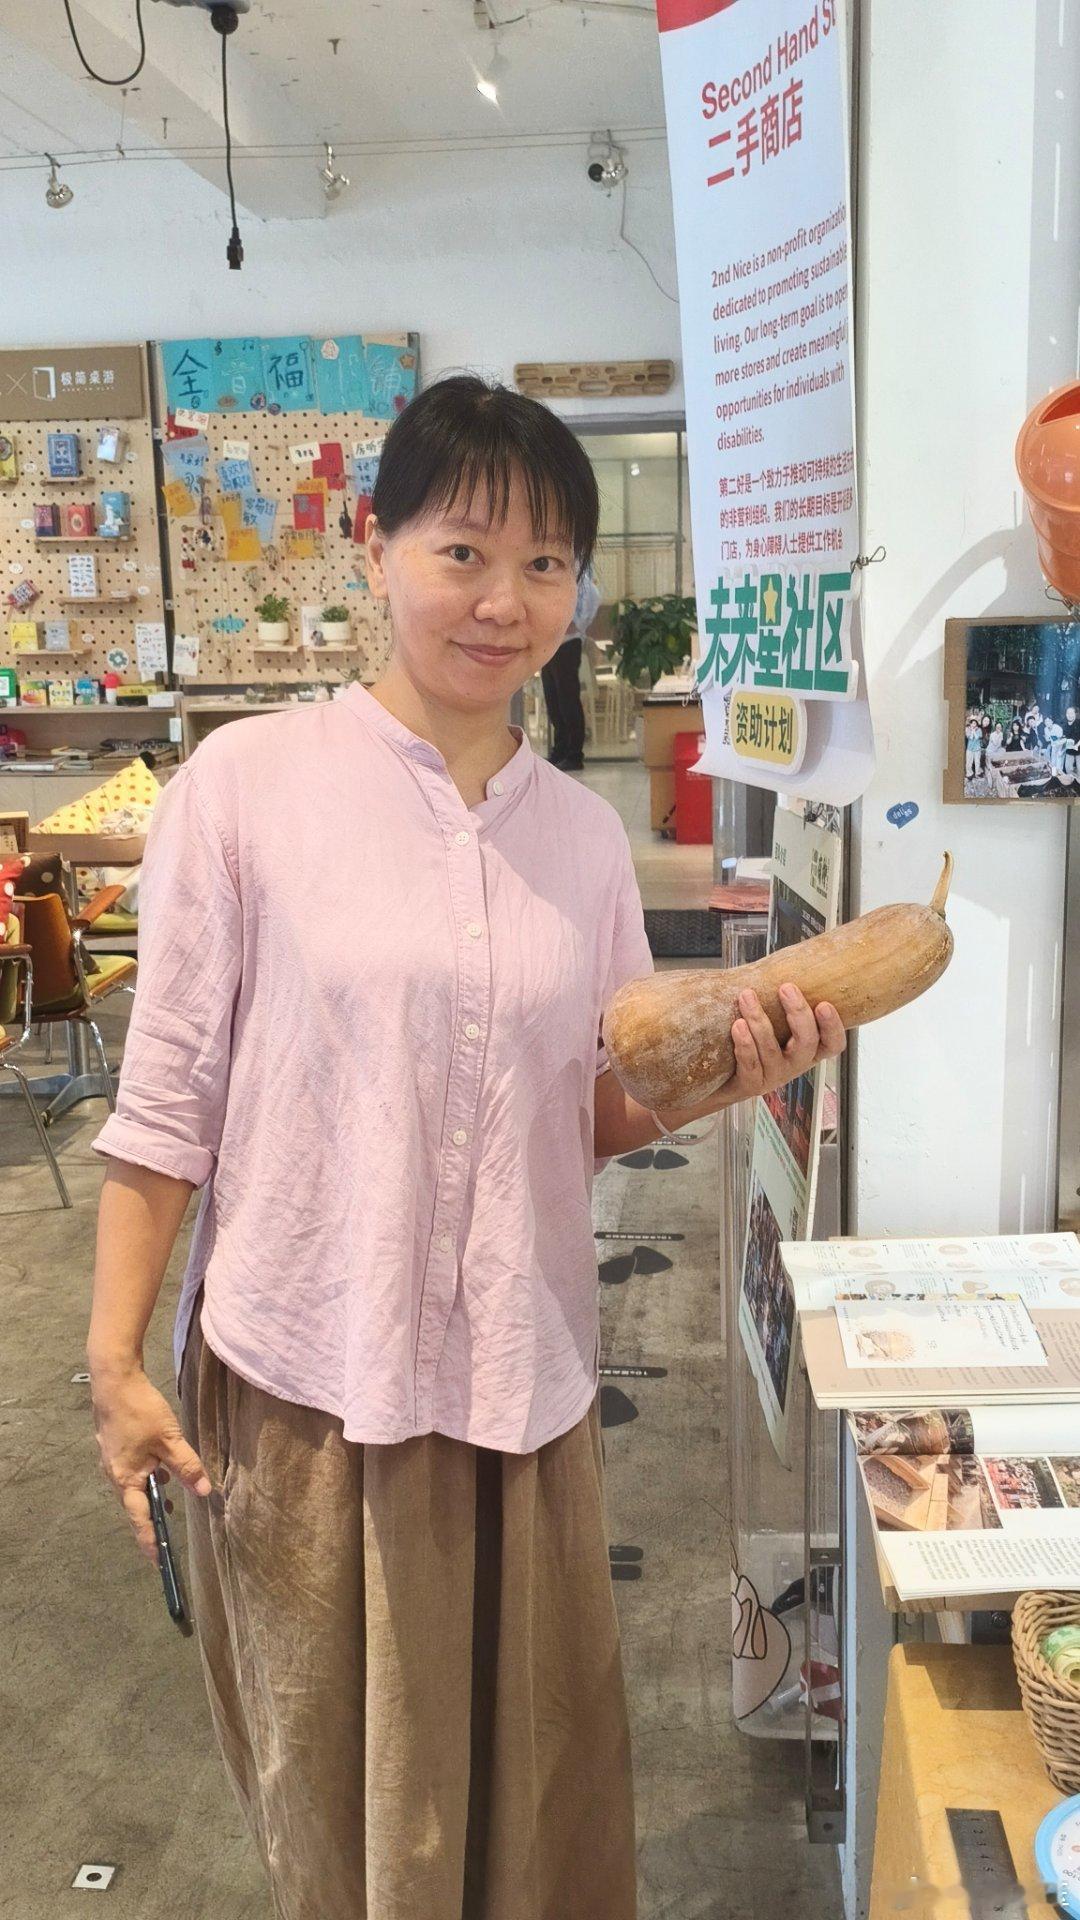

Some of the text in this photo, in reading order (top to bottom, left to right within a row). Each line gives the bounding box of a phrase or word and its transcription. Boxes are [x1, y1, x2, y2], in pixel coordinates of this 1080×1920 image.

[701, 45, 772, 120] Second
[777, 5, 818, 75] Hand
[707, 77, 803, 187] 二手商店
[711, 264, 731, 288] 2nd
[733, 260, 752, 281] Nice
[753, 253, 760, 273] is
[760, 254, 766, 269] a
[767, 228, 807, 265] non-profit
[713, 287, 757, 321] dedicated
[758, 286, 767, 304] to
[768, 267, 810, 306] promoting
[713, 332, 743, 355] living.
[744, 326, 759, 345] Our
[760, 310, 799, 339] long-term
[800, 296, 818, 328] goal
[818, 292, 825, 311] is
[825, 290, 834, 309] to
[715, 368, 740, 387] more
[741, 358, 765, 379] stores
[766, 348, 781, 370] and
[782, 343, 807, 366] create
[716, 361, 845, 422] opportunities for individuals with
[717, 425, 765, 451] disabilities.
[696, 571, 853, 694] 未来星社区
[736, 702, 794, 755] 资助计划
